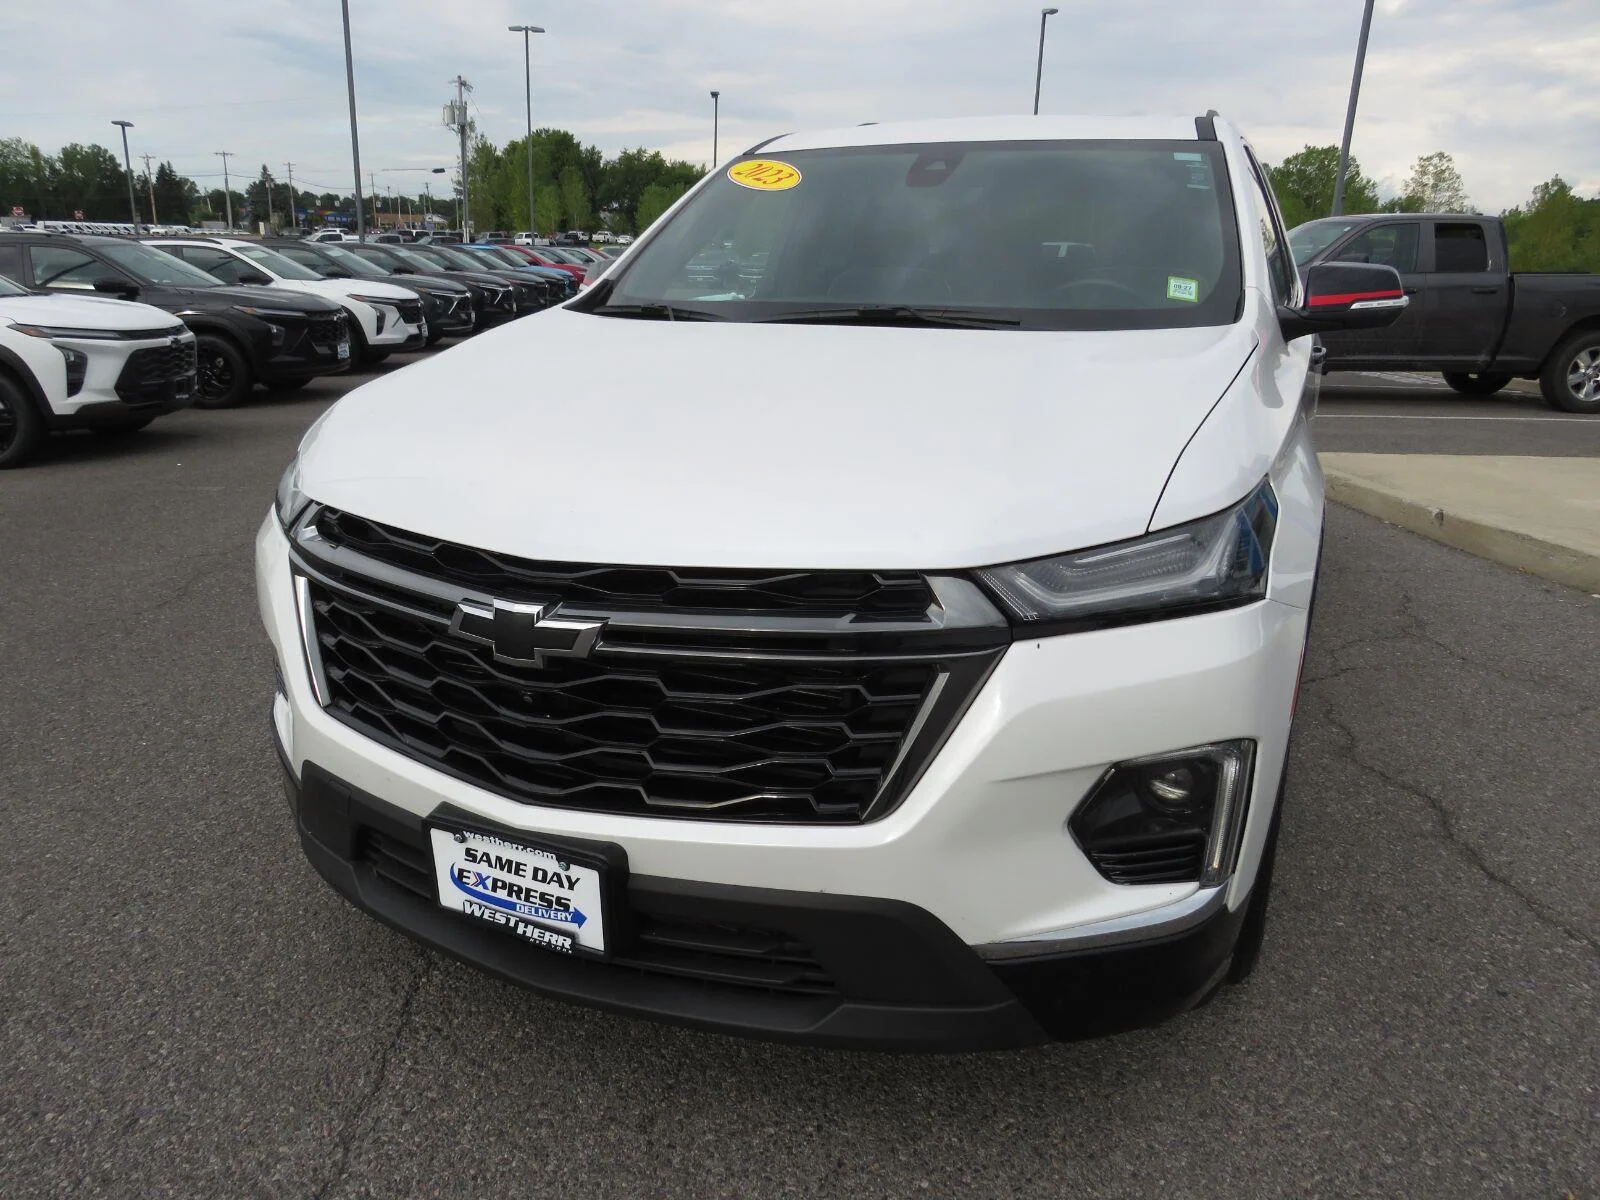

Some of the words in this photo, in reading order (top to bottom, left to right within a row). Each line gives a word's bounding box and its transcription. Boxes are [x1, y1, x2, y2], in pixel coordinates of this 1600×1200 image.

[734, 163, 794, 184] 2023
[463, 831, 557, 860] westherr.com
[464, 847, 528, 878] SAME
[532, 866, 581, 891] DAY
[457, 868, 572, 912] EXPRESS
[516, 903, 573, 921] DELIVERY
